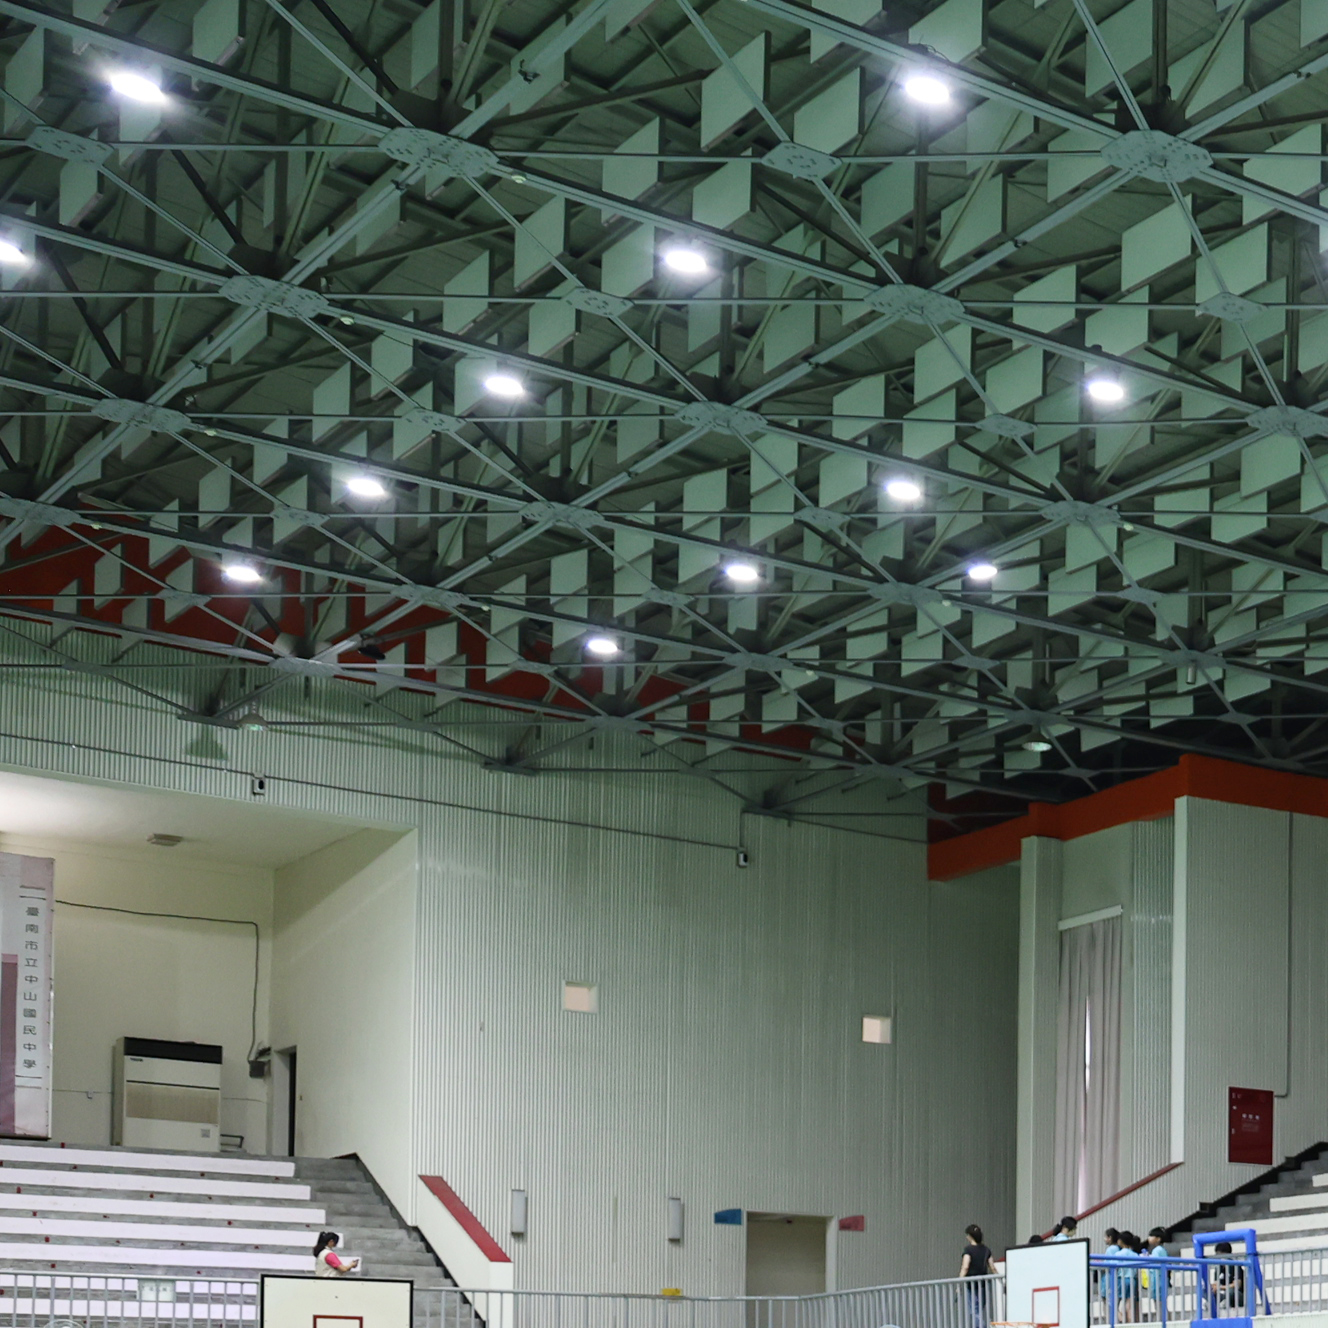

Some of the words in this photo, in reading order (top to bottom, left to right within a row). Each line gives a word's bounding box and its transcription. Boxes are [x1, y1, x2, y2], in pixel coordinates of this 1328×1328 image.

[23, 906, 40, 1069] 臺南市立中山國民中學
